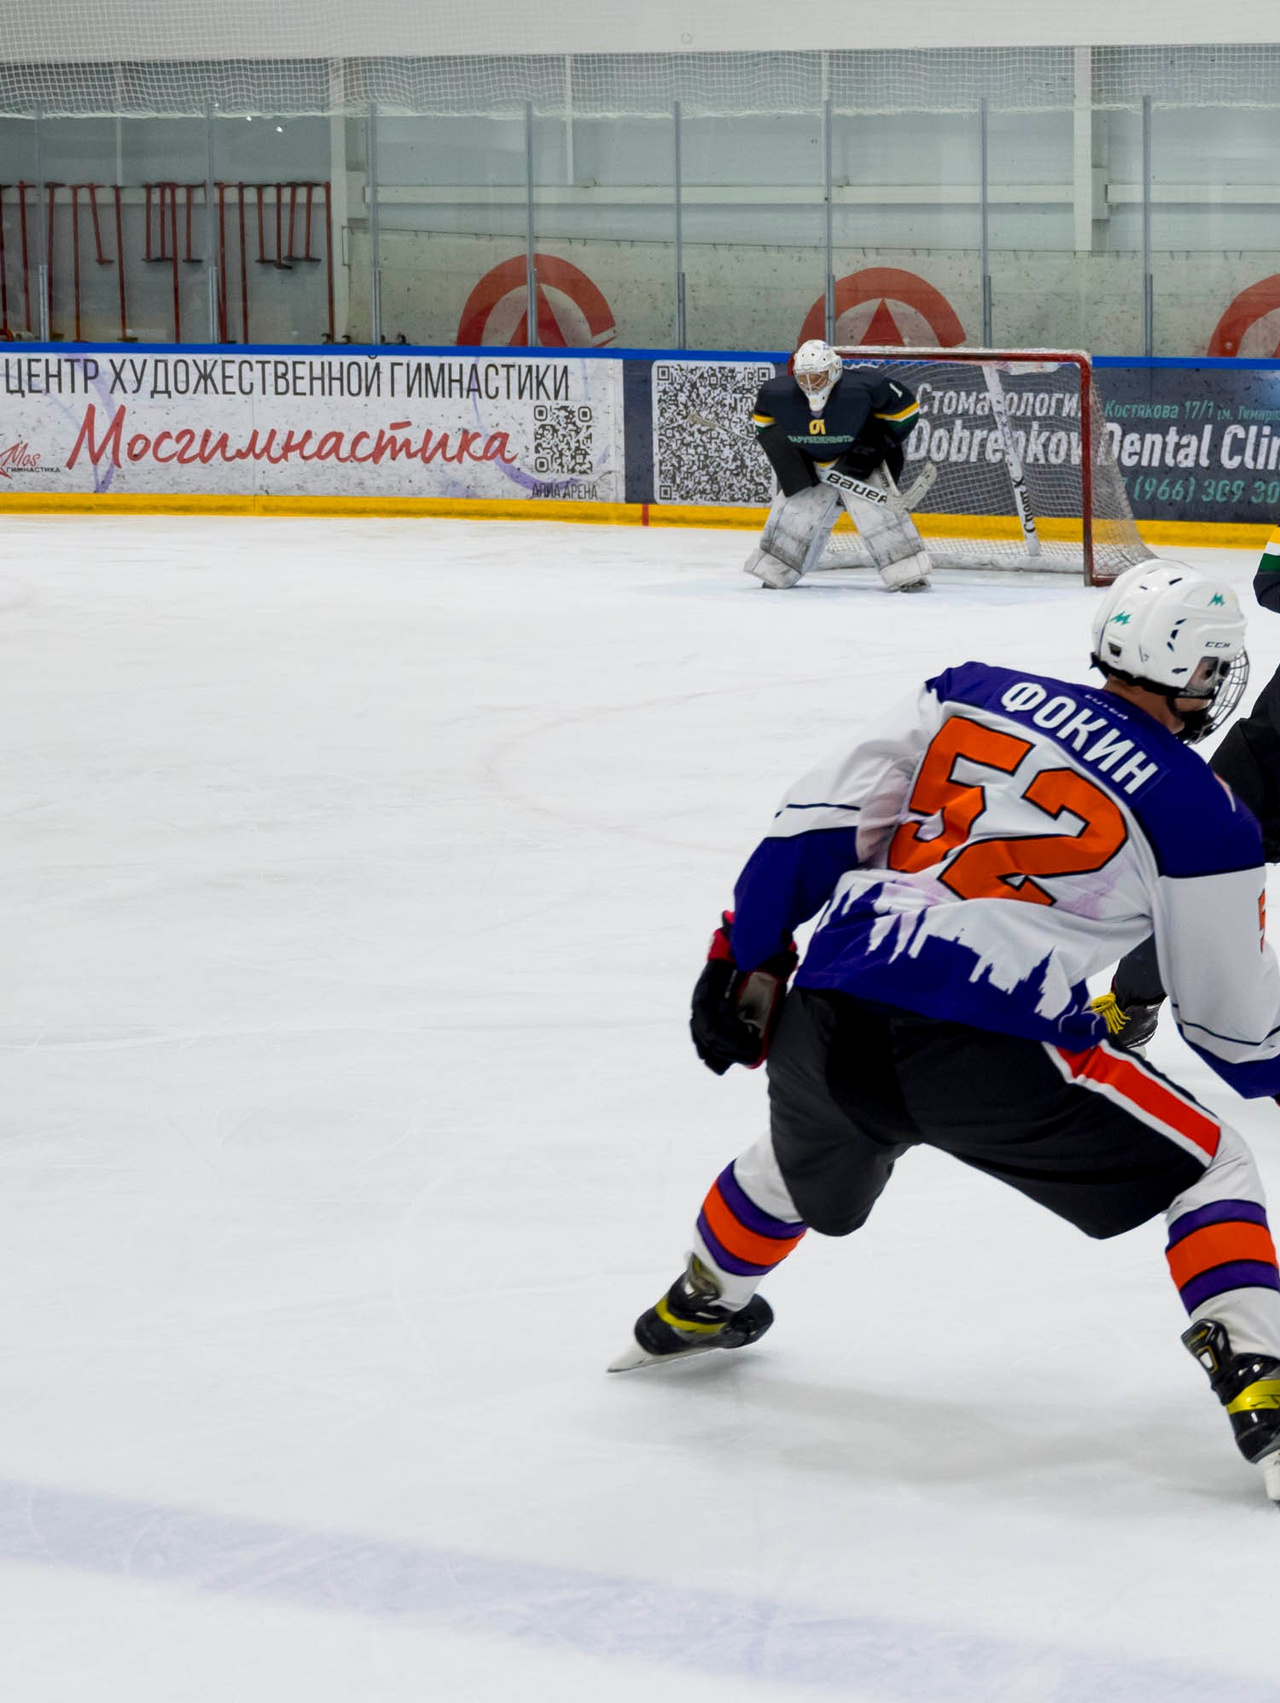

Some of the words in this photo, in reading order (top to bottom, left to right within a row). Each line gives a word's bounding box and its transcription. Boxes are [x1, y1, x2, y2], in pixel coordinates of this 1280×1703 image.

[5, 358, 99, 398] ЦЕНТР
[109, 355, 381, 399] ХУДОЖЕСТВЕННОЙ
[390, 362, 569, 401] ГИМНАСТИКИ
[1104, 400, 1179, 419] Костякова
[66, 402, 519, 470] Мосгимнастика
[1098, 422, 1213, 469] Dental
[563, 480, 598, 500] АРЕНА
[1133, 476, 1195, 503] (966)
[1201, 479, 1245, 503] 309
[1251, 481, 1280, 504] 30
[1205, 641, 1231, 649] CCM
[1000, 681, 1159, 795] ФОКИН
[887, 715, 1129, 907] 52
